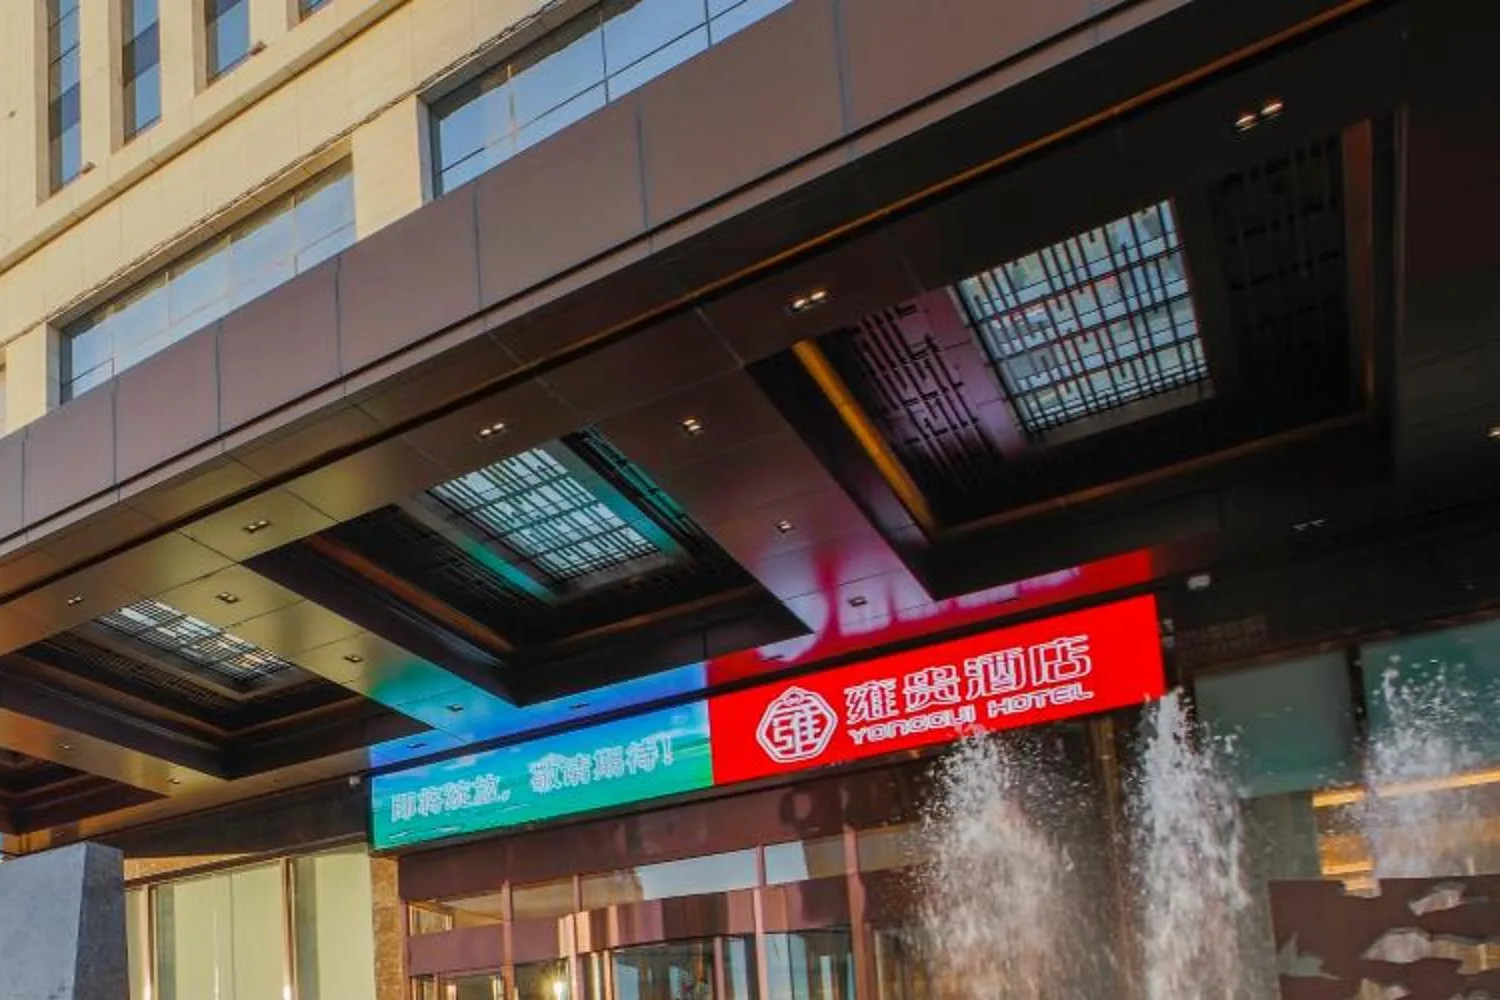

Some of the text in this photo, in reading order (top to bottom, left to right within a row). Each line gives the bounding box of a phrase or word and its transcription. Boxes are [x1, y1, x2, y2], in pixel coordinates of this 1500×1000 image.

[843, 635, 1092, 724] 雍贵酒店
[987, 683, 1094, 719] HOTEL
